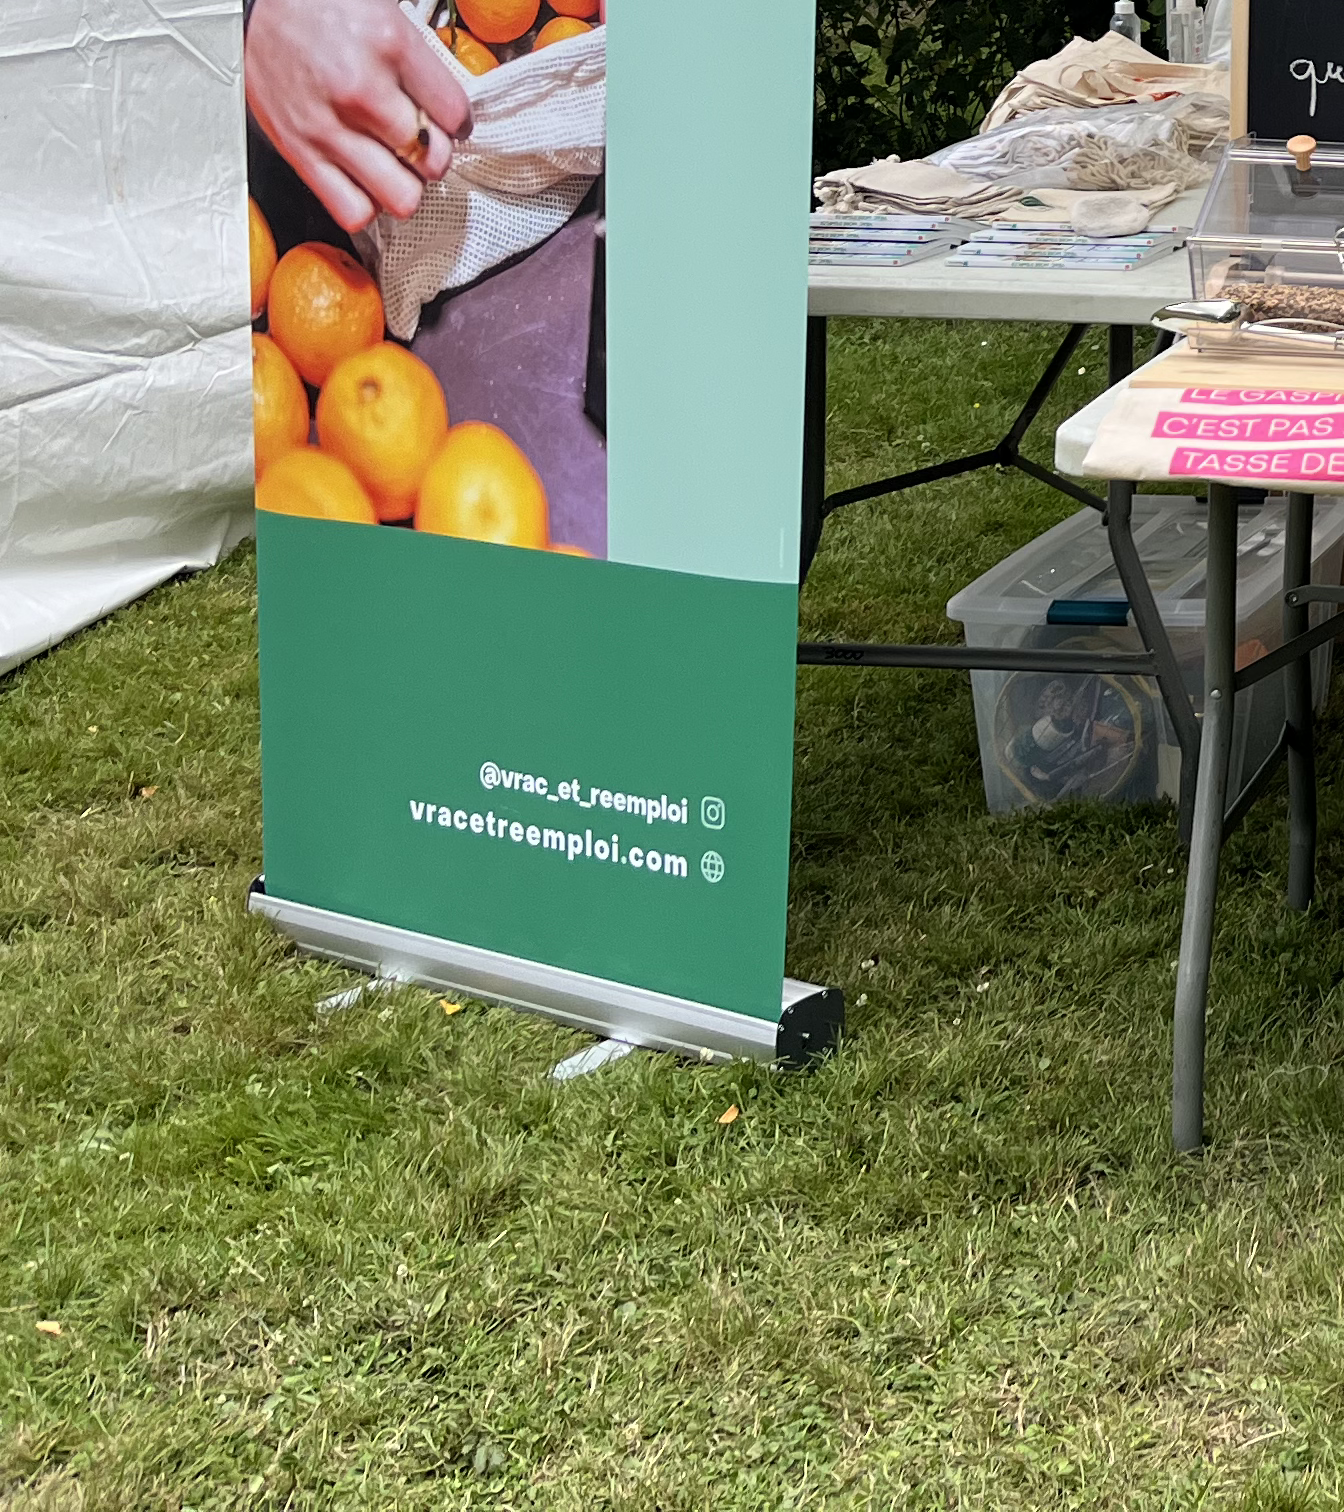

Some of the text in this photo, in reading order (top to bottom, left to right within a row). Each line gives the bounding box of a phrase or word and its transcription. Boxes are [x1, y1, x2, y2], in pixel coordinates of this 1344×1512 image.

[1268, 418, 1335, 438] PAS
[1183, 450, 1293, 474] TASSE
[479, 760, 688, 825] @vrac_et_reemploi
[409, 798, 688, 878] vracetreemploi.com
